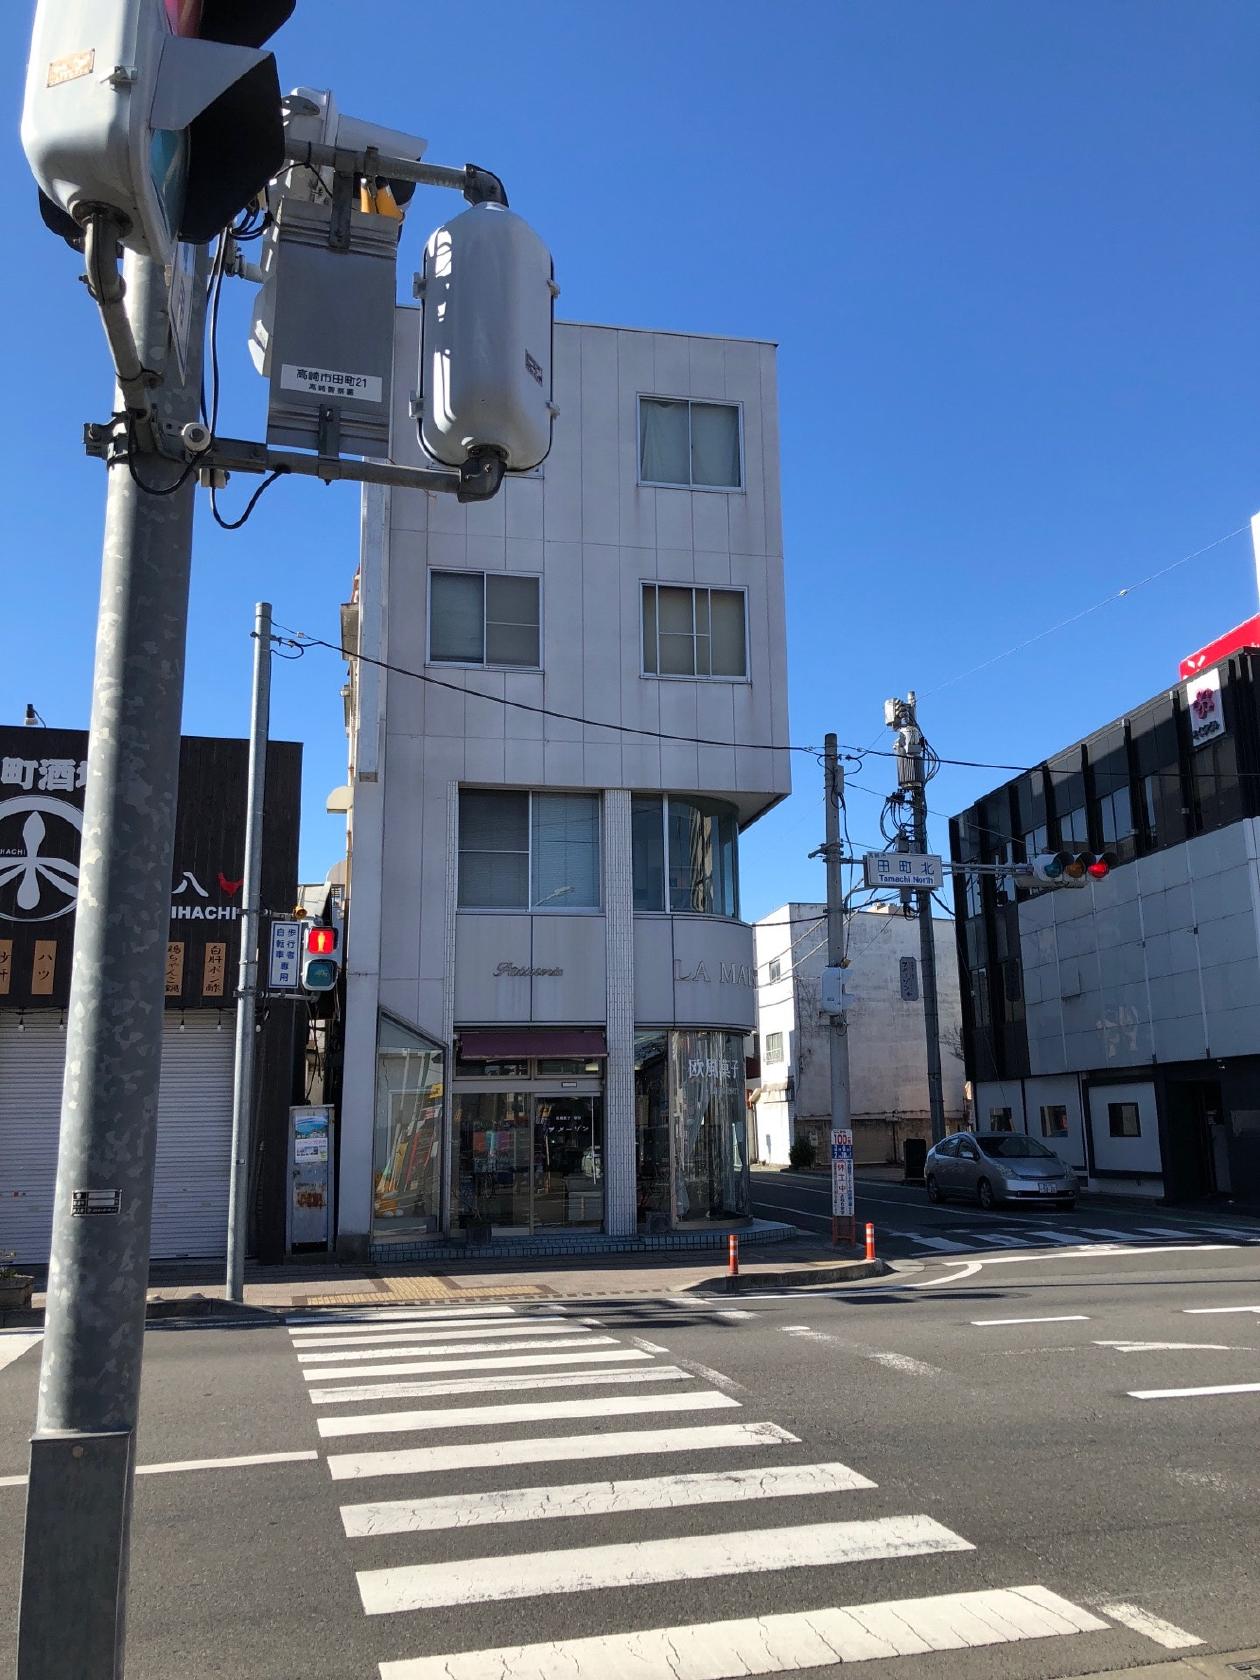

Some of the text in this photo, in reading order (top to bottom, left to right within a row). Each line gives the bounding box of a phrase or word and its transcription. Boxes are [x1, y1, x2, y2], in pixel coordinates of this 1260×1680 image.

[296, 368, 368, 388] 高崎市田町21
[878, 860, 934, 875] 田町北
[879, 874, 934, 884] Tamachi North
[38, 954, 53, 981] ハツ
[674, 959, 712, 984] LA
[688, 1058, 739, 1079] 欧風菓子
